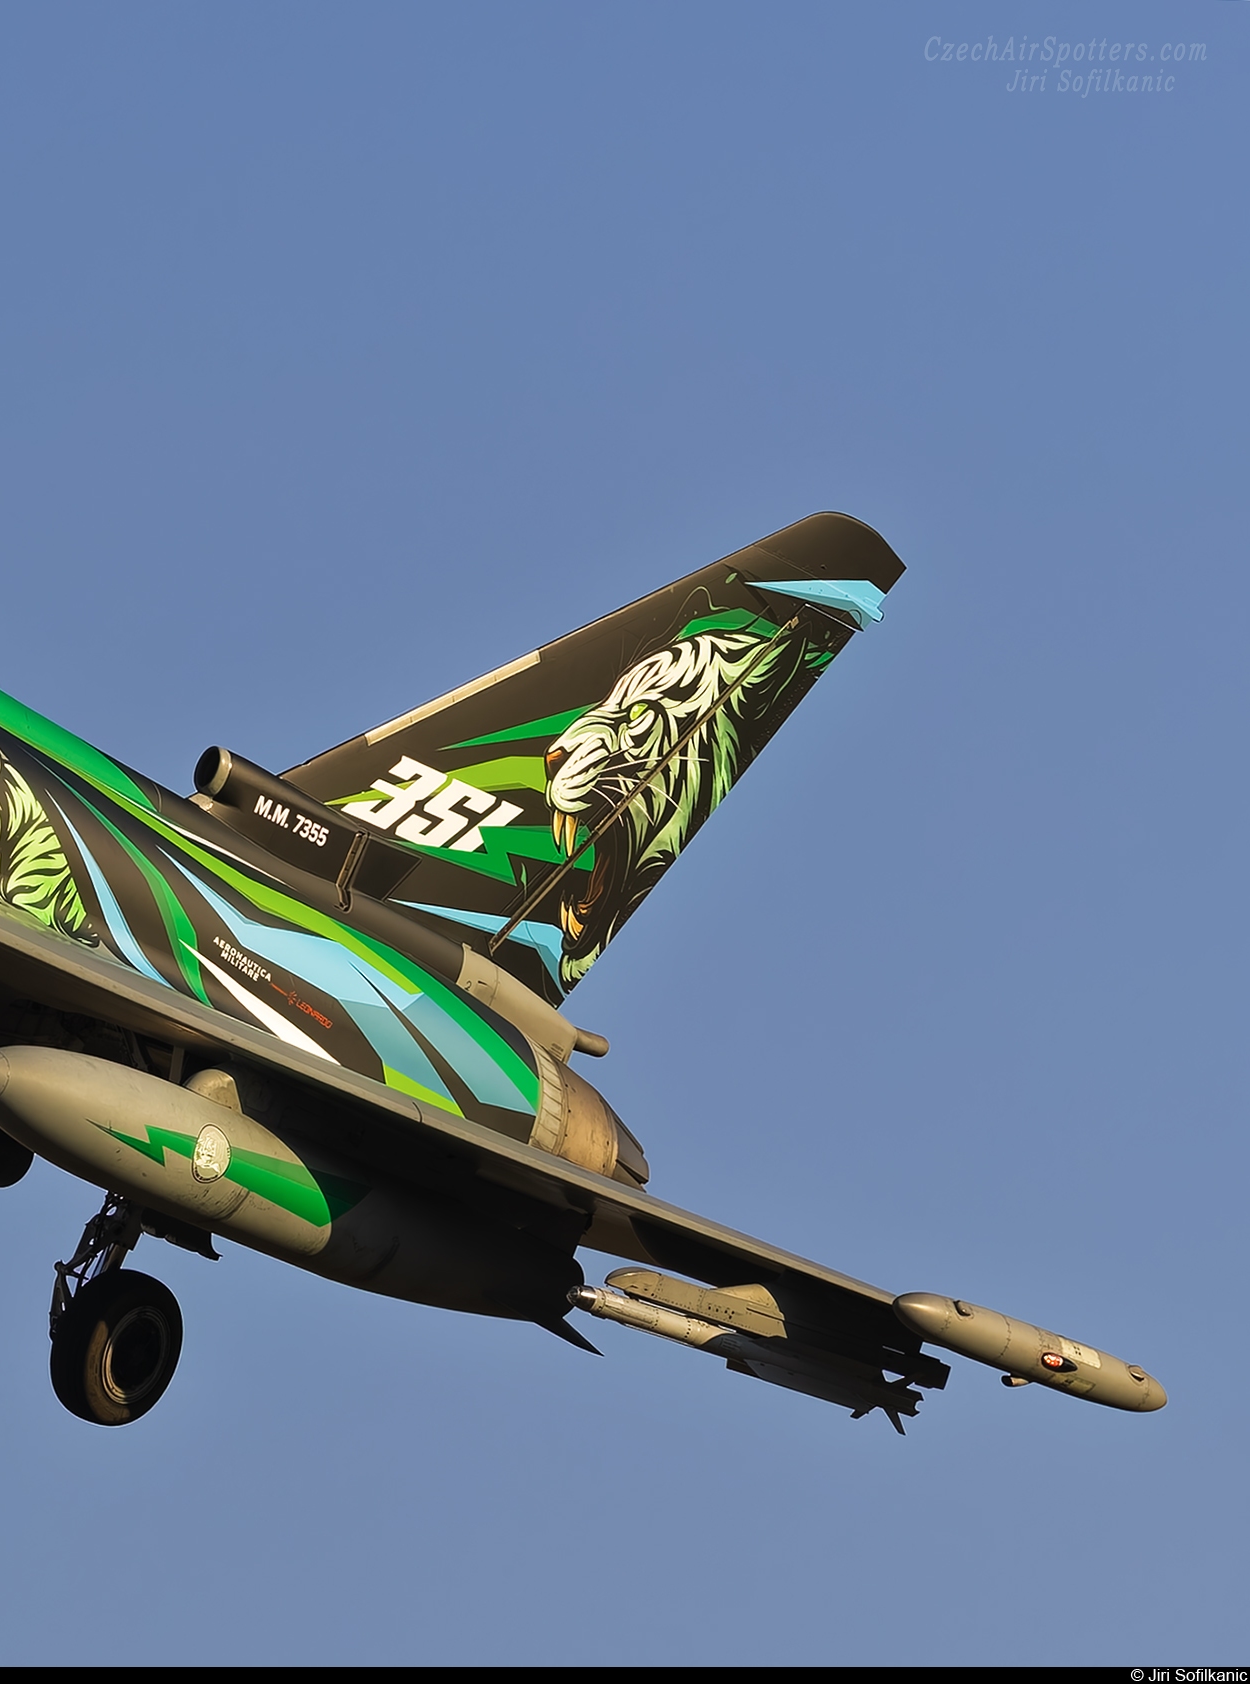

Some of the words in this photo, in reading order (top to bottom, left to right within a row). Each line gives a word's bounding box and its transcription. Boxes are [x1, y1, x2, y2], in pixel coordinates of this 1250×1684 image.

[253, 795, 291, 829] M.M.
[292, 813, 330, 847] 7355
[212, 936, 272, 982] AERONAUTICA
[220, 950, 260, 982] MILITARE
[296, 999, 333, 1029] LEONARDO
